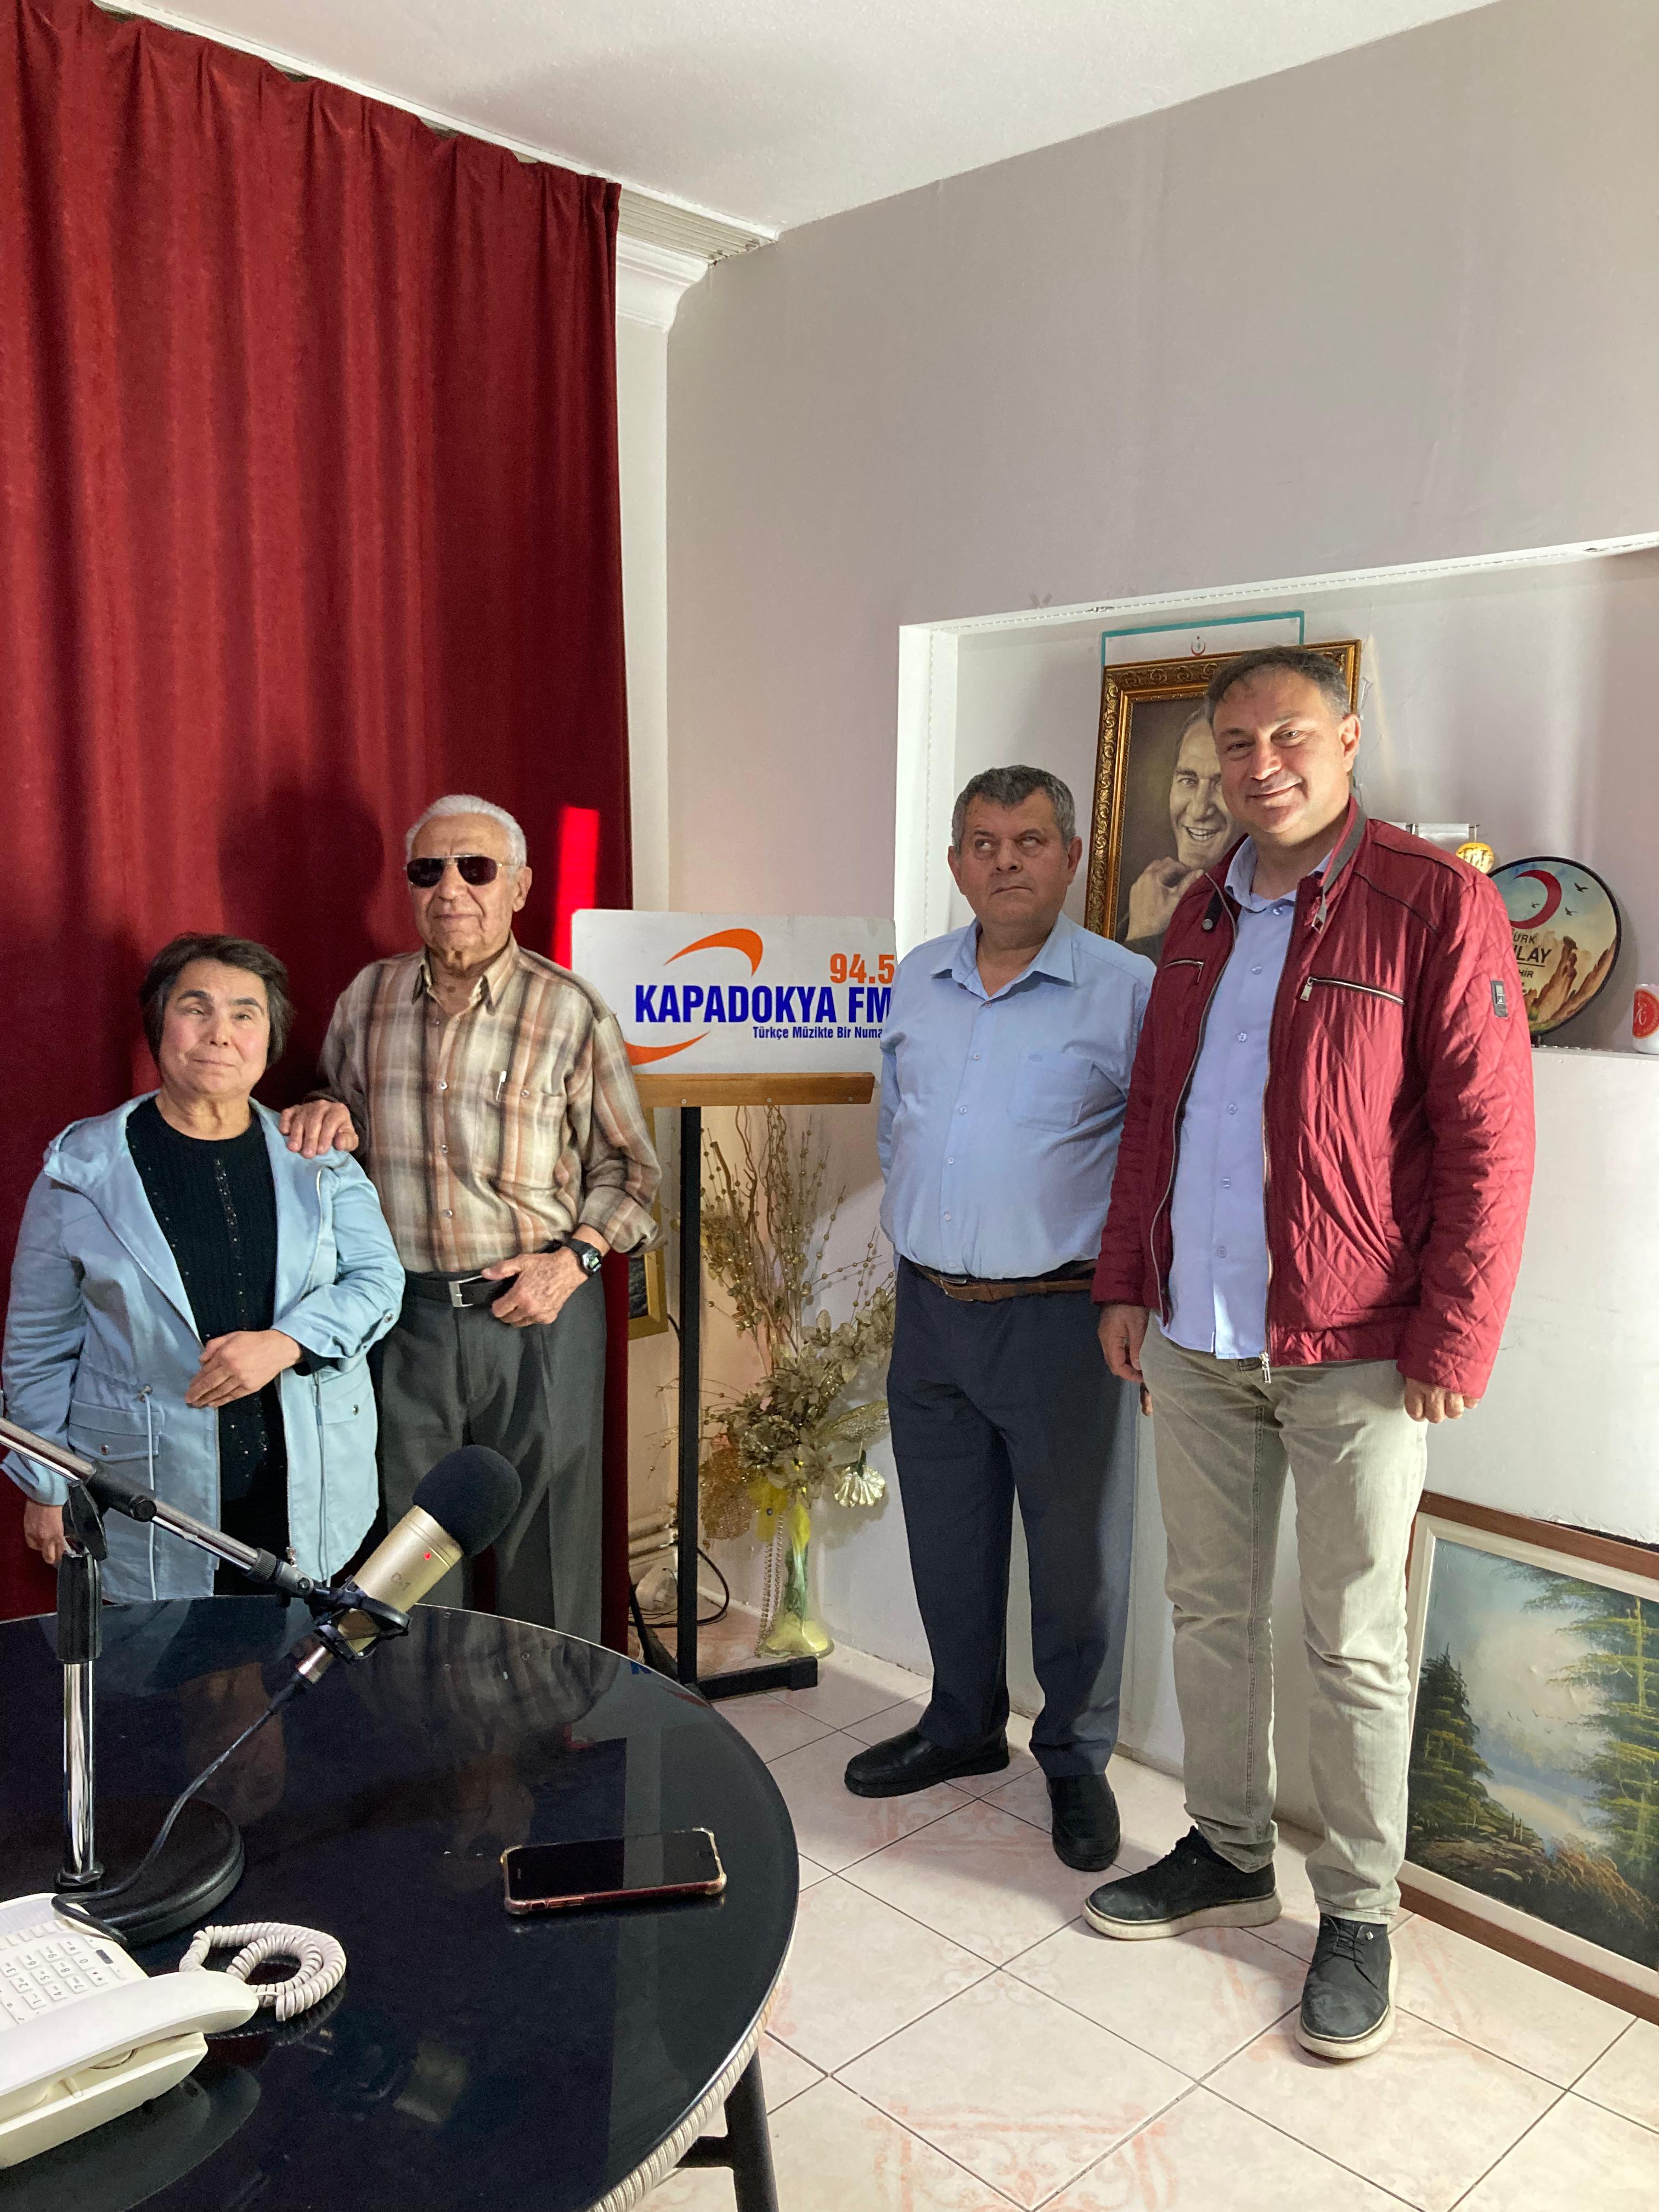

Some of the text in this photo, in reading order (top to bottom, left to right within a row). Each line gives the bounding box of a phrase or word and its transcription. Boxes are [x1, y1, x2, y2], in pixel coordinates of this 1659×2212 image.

[830, 953, 895, 984] 94.5
[635, 985, 891, 1024] KAPADOKYA FM
[753, 1026, 788, 1040] Türkçe
[792, 1026, 833, 1038] Müzikte
[837, 1026, 851, 1038] Bir
